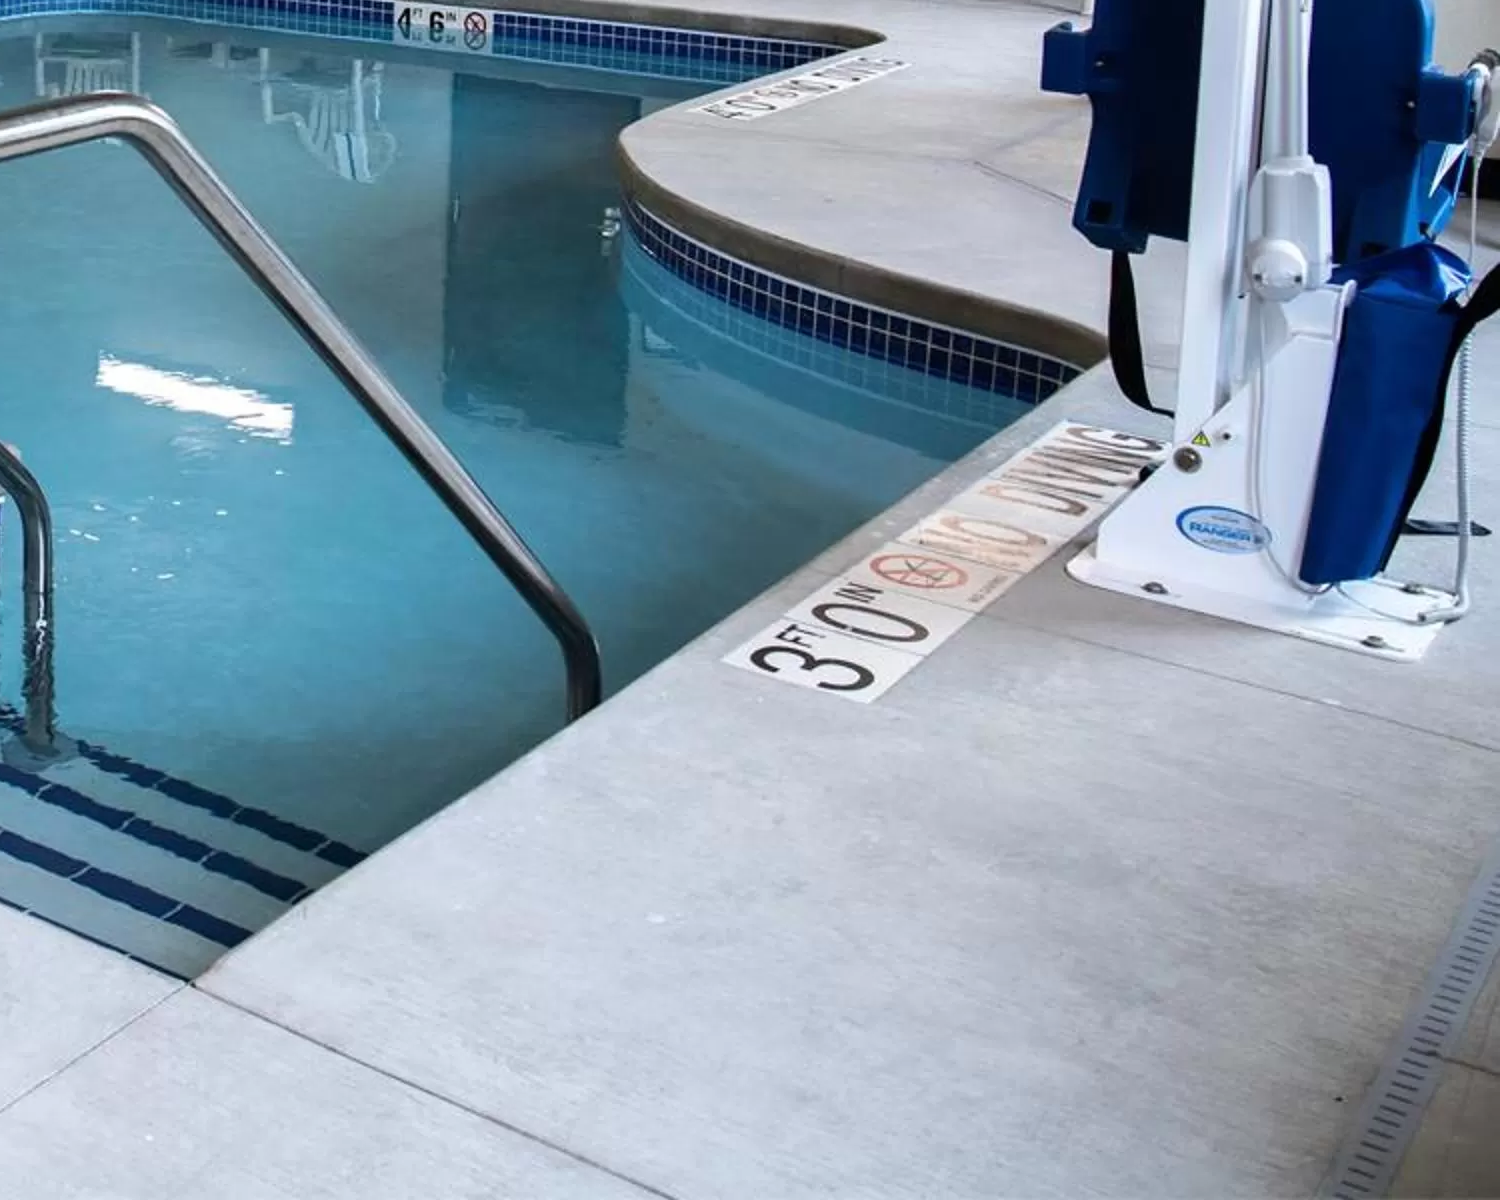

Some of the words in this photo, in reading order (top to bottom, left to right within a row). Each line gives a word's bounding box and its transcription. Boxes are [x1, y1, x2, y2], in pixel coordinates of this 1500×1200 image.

[398, 7, 411, 25] 4
[430, 10, 445, 29] 6
[980, 426, 1163, 517] DIVING
[916, 514, 1048, 569] NO
[833, 580, 885, 604] IN
[775, 623, 826, 649] FT
[811, 602, 930, 643] 0
[749, 644, 875, 692] 3
